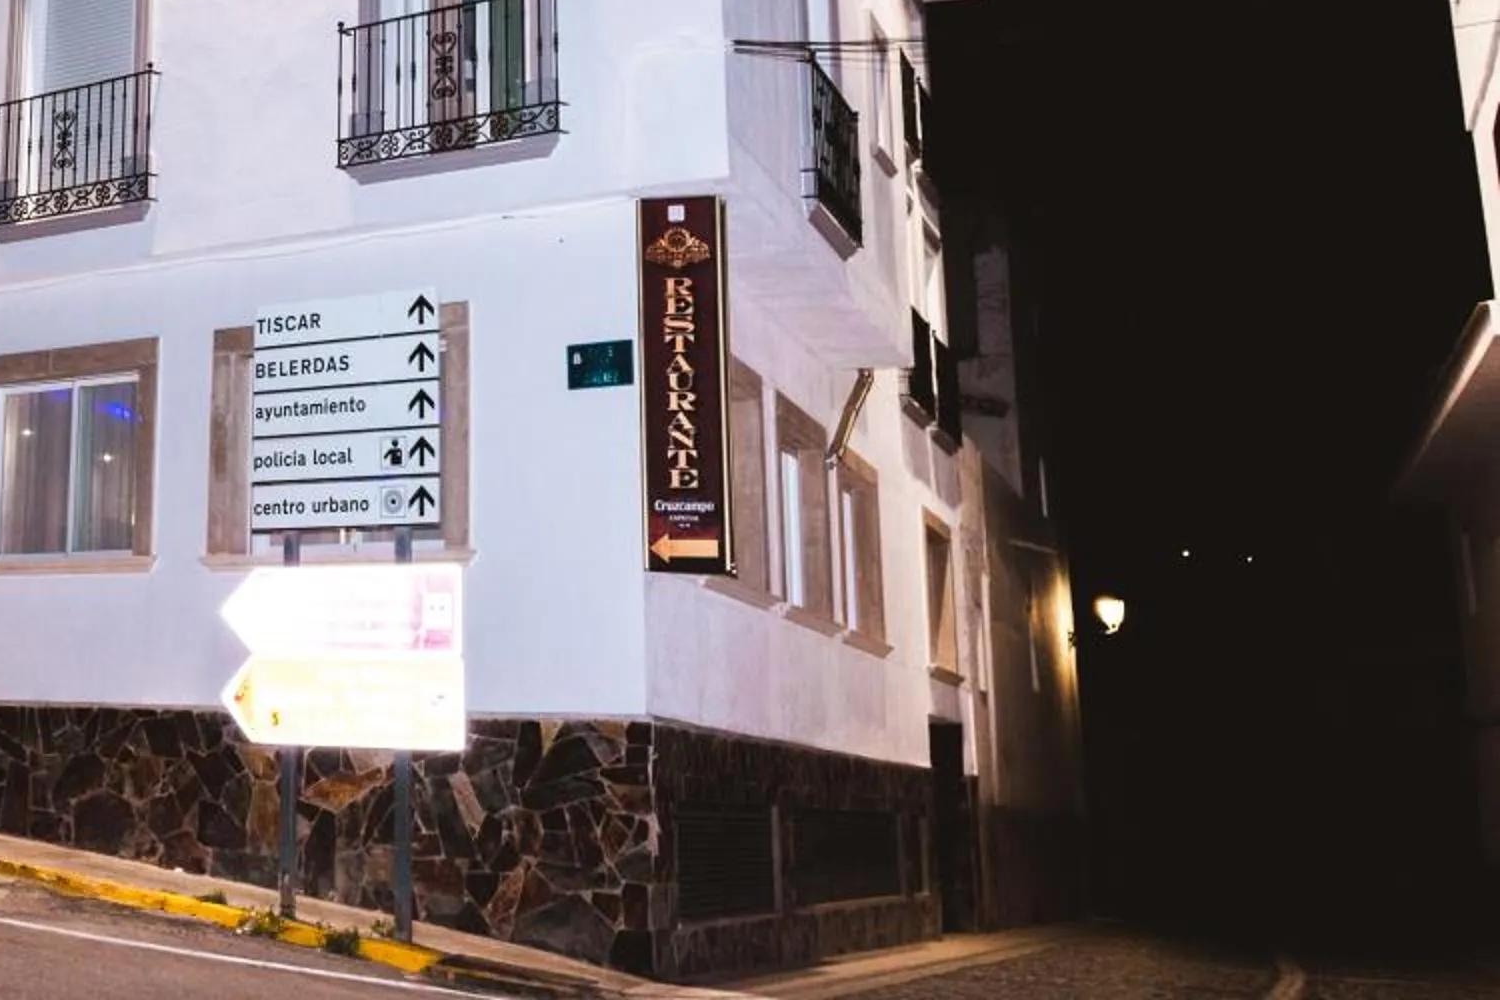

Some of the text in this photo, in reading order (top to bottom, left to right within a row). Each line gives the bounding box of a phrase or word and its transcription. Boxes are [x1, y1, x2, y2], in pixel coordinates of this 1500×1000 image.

[256, 312, 322, 336] TISCAR
[254, 355, 350, 380] BELERDAS
[662, 276, 699, 490] RESTAURANTE
[254, 397, 367, 421] ayuntamiento
[312, 446, 353, 467] local
[253, 495, 369, 517] centro urbano
